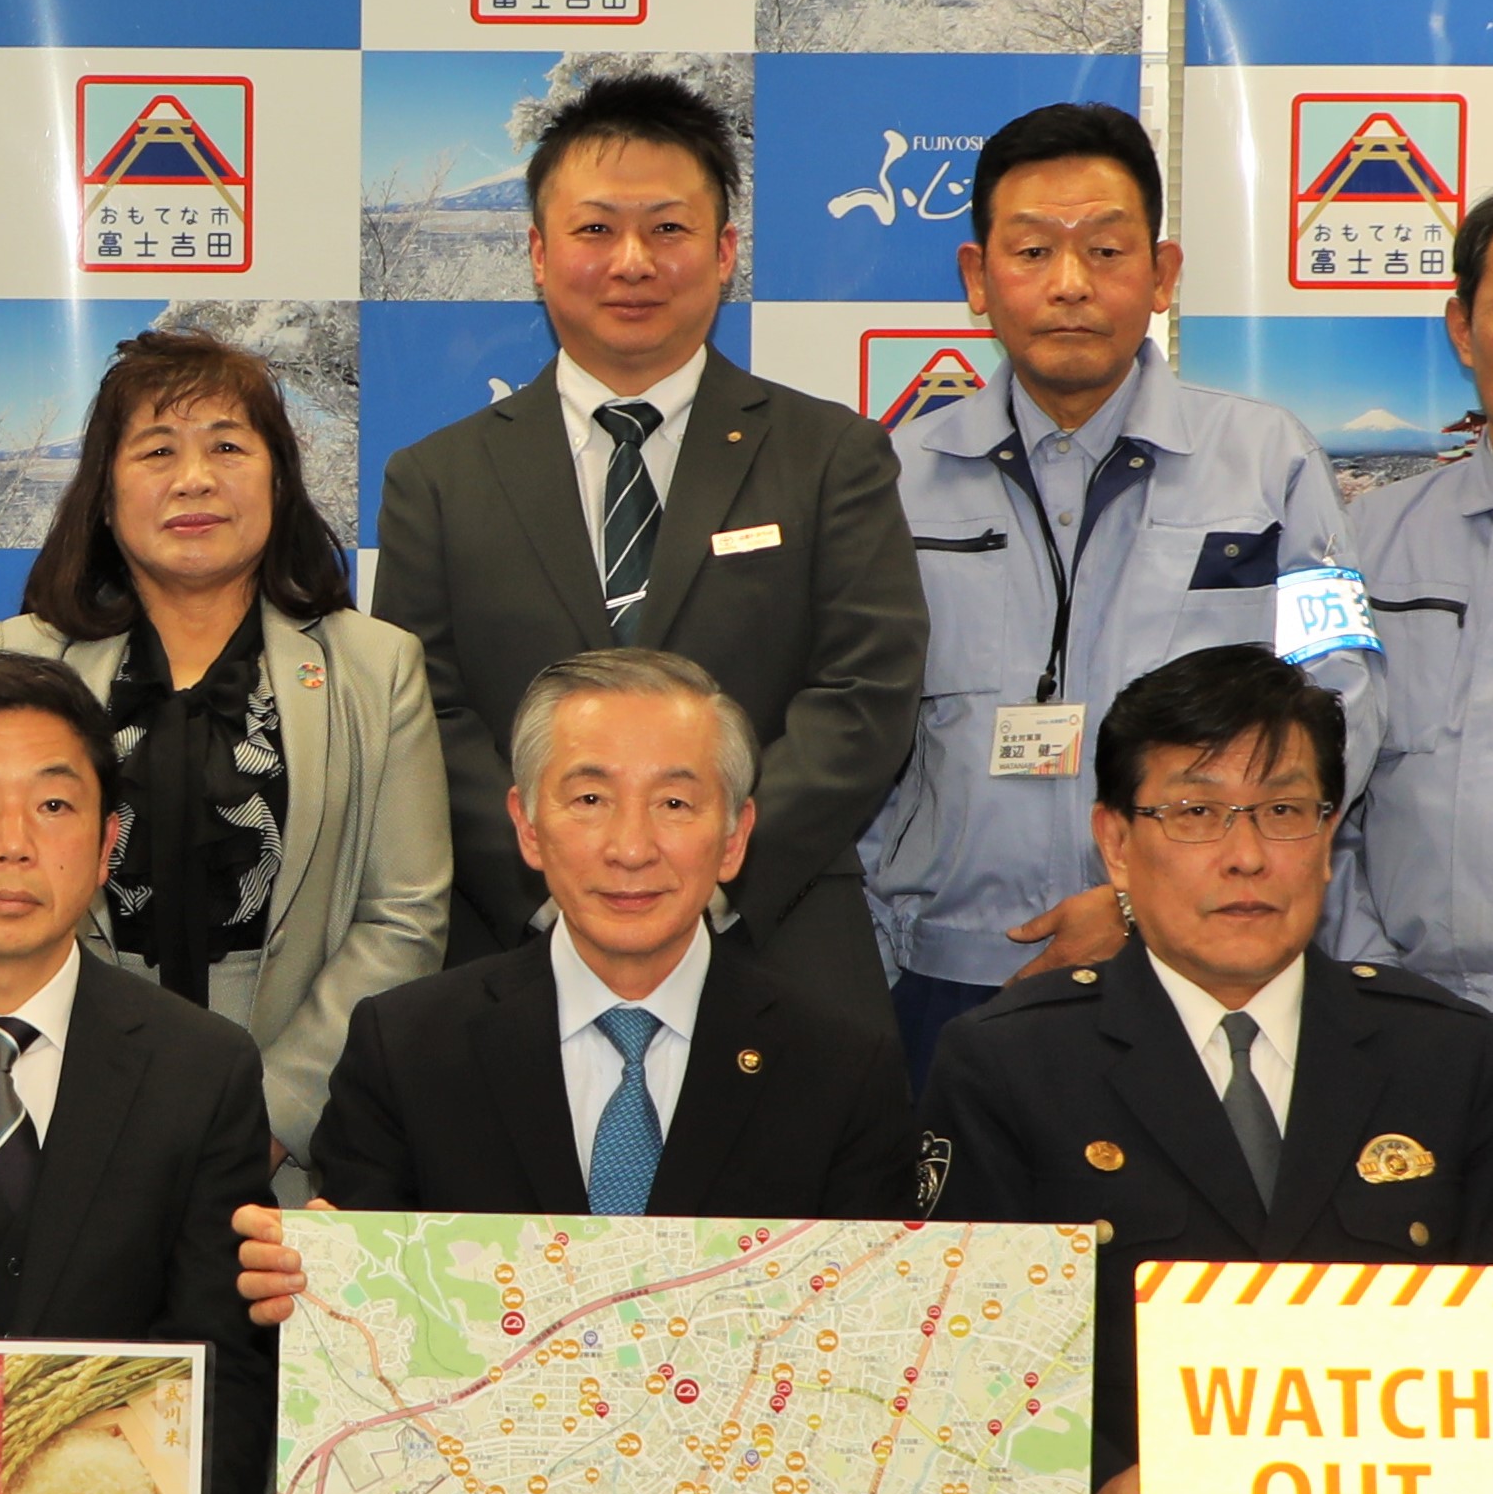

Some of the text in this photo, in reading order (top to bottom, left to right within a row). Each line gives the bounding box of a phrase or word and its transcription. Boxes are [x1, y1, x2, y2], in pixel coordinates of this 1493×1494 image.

[100, 206, 230, 226] おもてな市
[97, 230, 232, 258] 富士吉田
[1313, 223, 1443, 243] おもてな市
[1310, 248, 1445, 275] 富士吉田
[1179, 1366, 1493, 1439] WATCH
